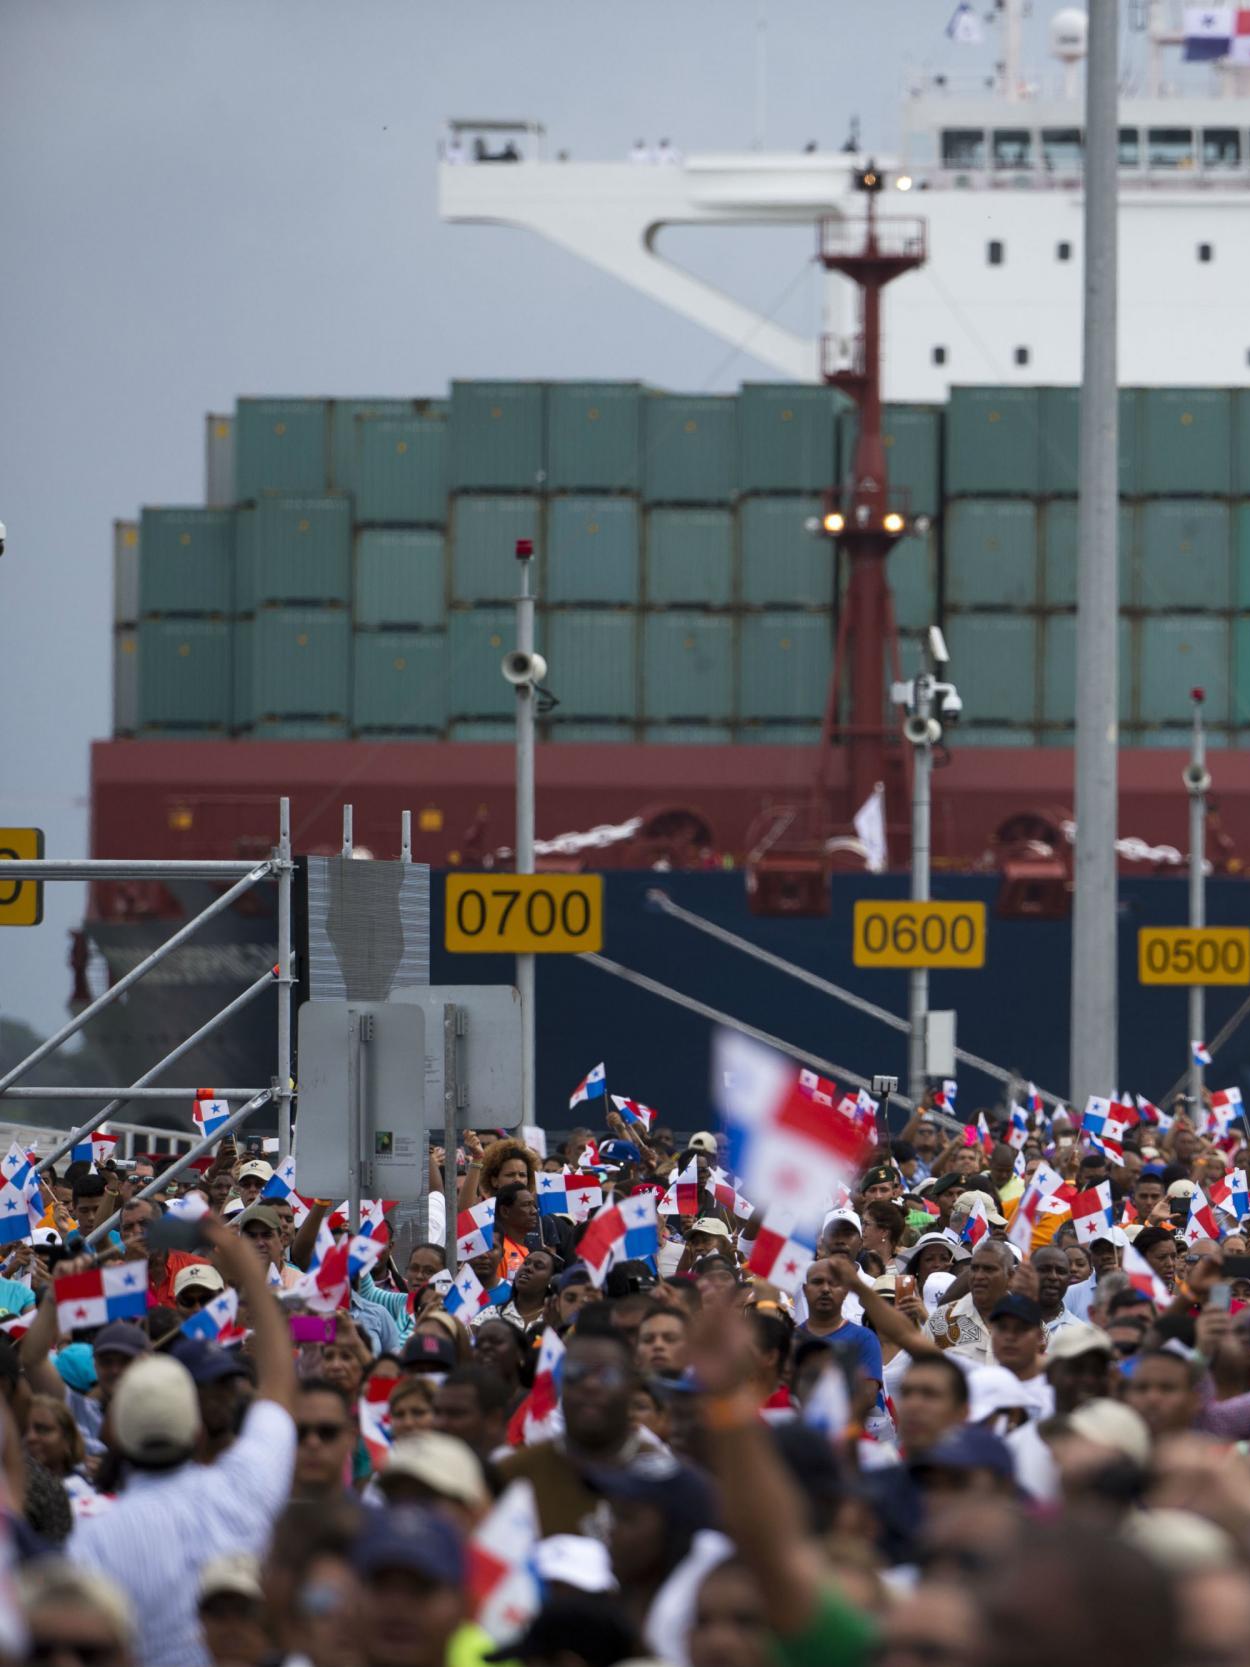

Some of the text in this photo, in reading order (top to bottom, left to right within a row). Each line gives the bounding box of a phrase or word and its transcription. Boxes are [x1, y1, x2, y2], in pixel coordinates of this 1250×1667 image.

[457, 889, 591, 937] 0700
[863, 913, 975, 955] 0600
[1147, 937, 1246, 975] 0500
